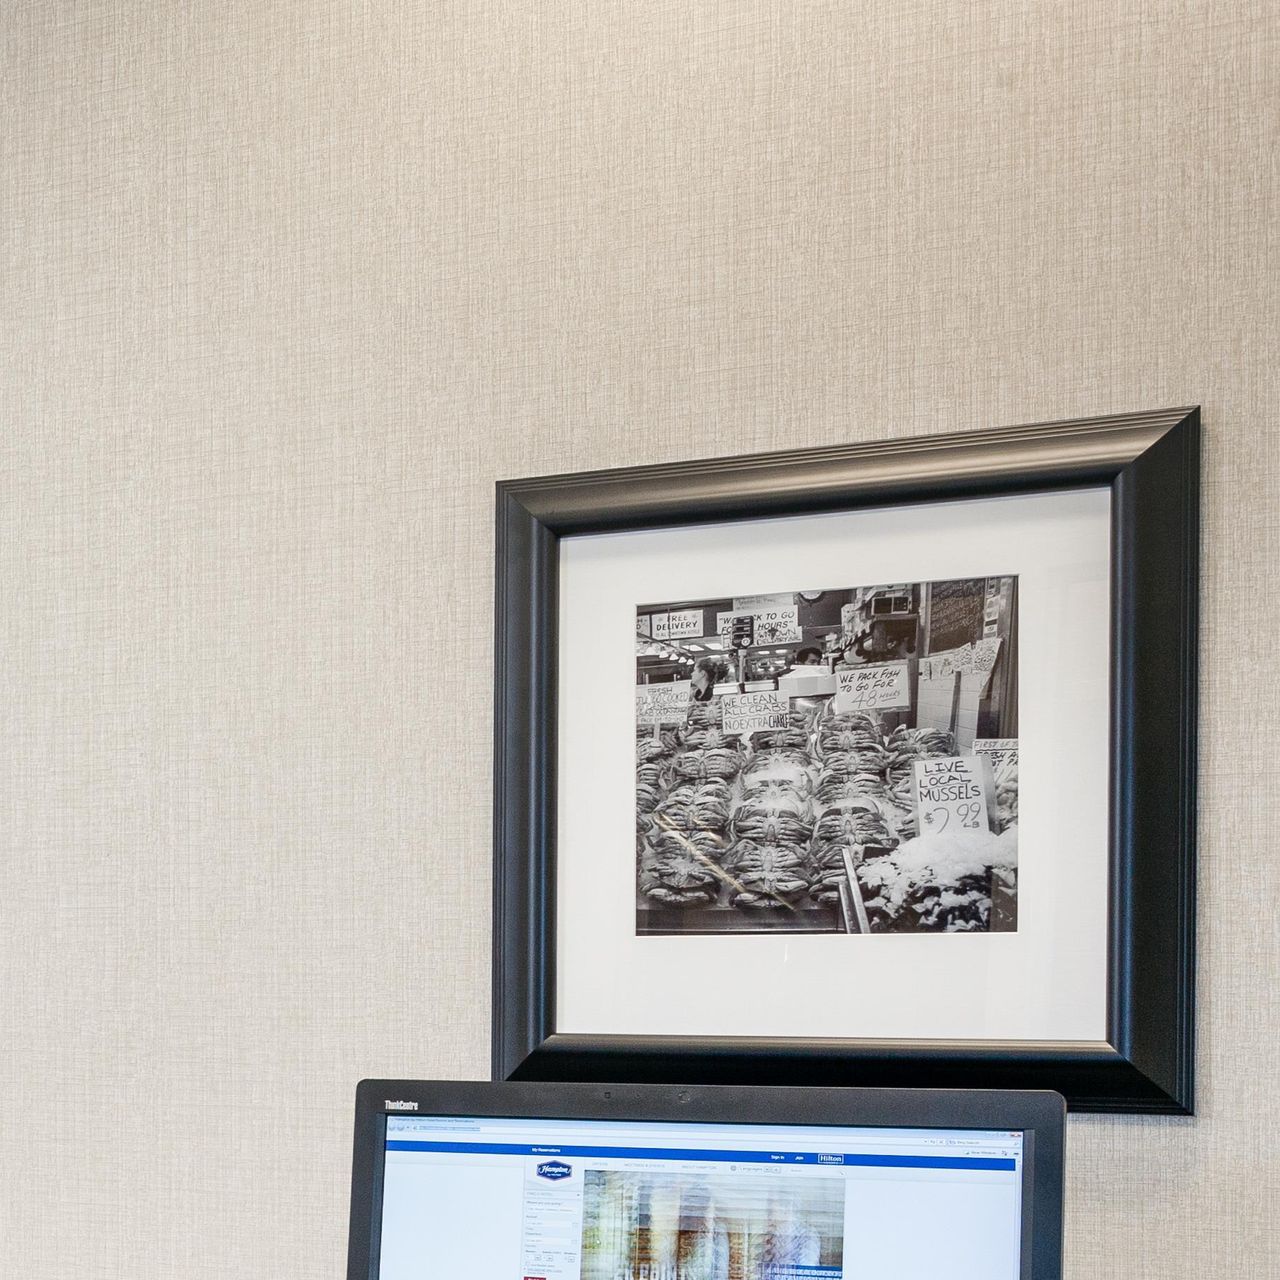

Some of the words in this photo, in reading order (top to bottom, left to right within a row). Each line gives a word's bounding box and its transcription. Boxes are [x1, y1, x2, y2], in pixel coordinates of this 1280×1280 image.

[781, 611, 794, 619] GO
[656, 621, 698, 631] DELIVERY
[840, 675, 855, 684] WE
[857, 672, 877, 682] PACK
[880, 668, 900, 678] FISH
[840, 685, 851, 693] TO
[856, 683, 869, 692] GO
[873, 679, 894, 688] FOR
[724, 697, 737, 708] WE
[740, 693, 777, 705] CLEAN
[724, 705, 744, 714] ALL
[749, 703, 788, 713] CRABS
[924, 761, 969, 774] LIVE
[919, 775, 971, 788] LOCAL
[920, 784, 981, 802] MUSSELS
[385, 1100, 418, 1110] ThinkCentre
[540, 1165, 571, 1174] Hampton
